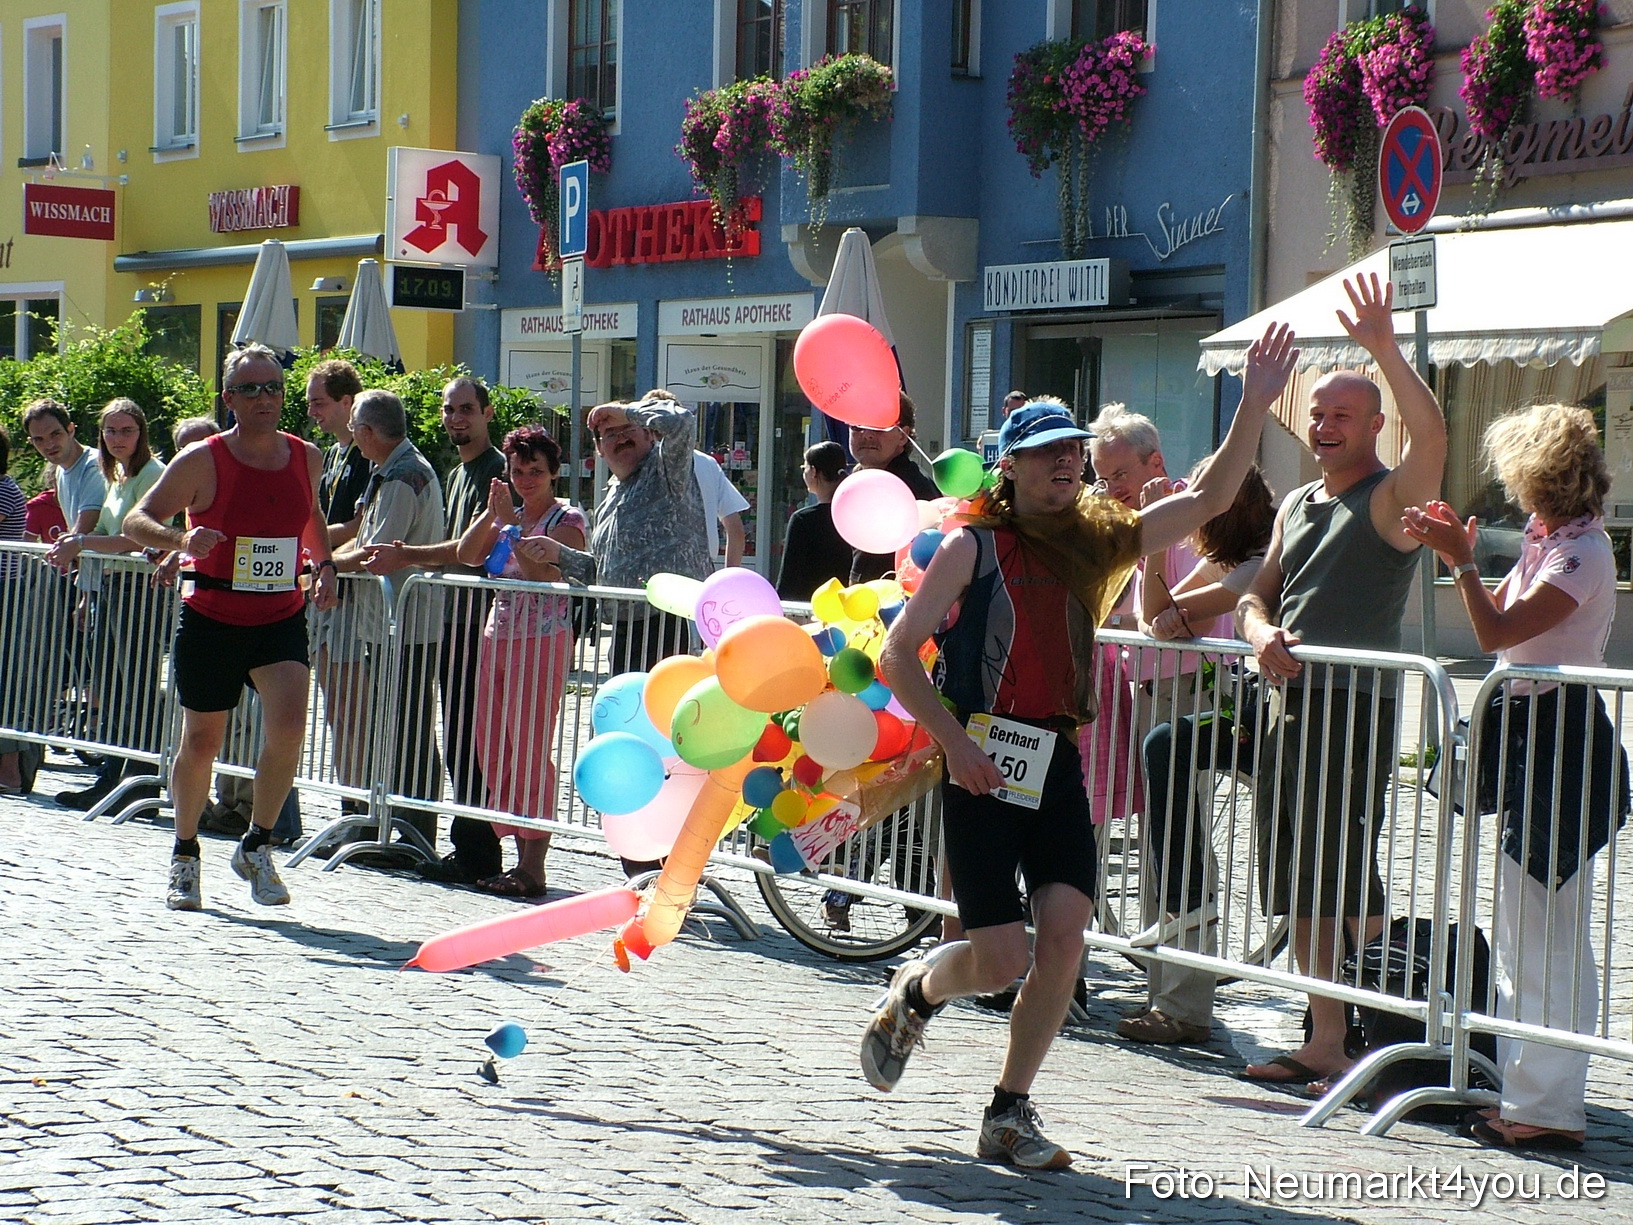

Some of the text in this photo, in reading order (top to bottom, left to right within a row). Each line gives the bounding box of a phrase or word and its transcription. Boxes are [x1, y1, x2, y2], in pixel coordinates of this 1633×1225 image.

[29, 201, 111, 223] WISSMACH
[208, 185, 292, 232] WISSMACH
[565, 176, 580, 244] P
[1106, 205, 1128, 238] DER
[531, 197, 762, 271] OTHEKE
[986, 265, 1105, 307] KONDITOREI WITTL
[521, 315, 563, 333] RATHAUS
[582, 312, 618, 331] OTHEKE
[682, 303, 792, 326] RATHAUS APOTHEKE
[685, 367, 700, 375] Haus
[712, 364, 747, 376] Gesundheit
[252, 544, 279, 554] Ernst-
[238, 557, 284, 577] C 928
[989, 725, 1040, 751] Gerhard
